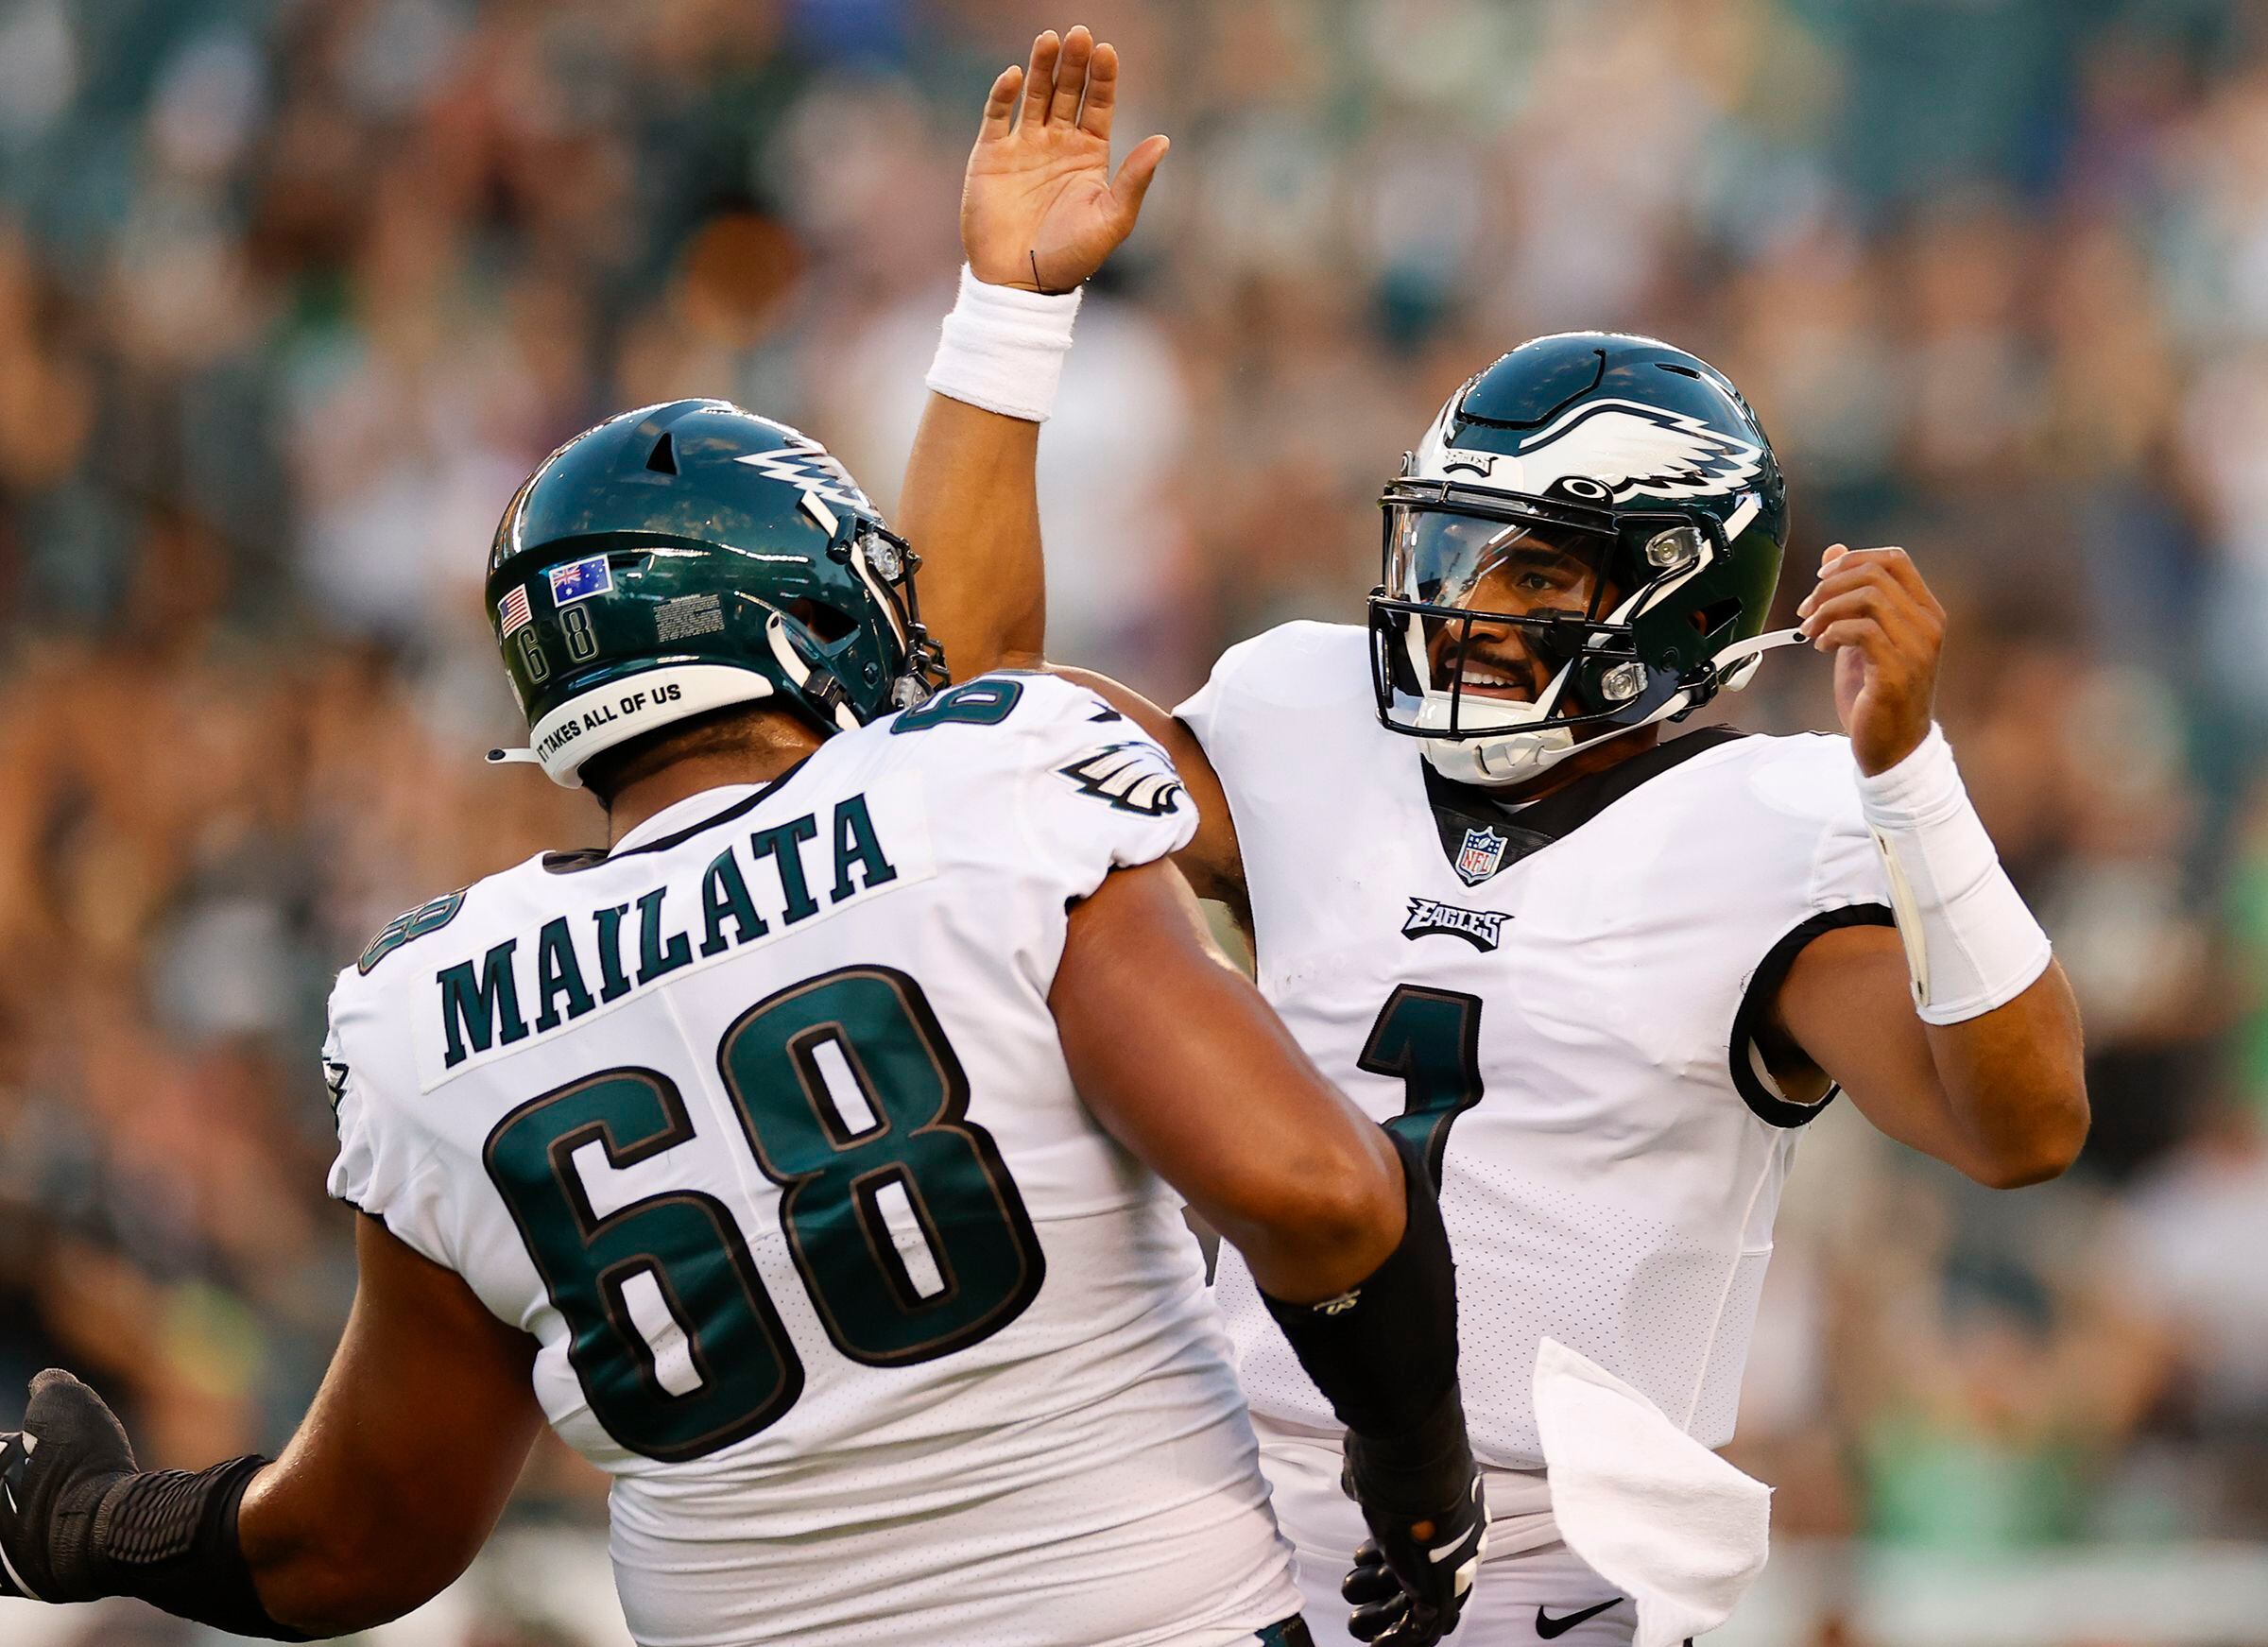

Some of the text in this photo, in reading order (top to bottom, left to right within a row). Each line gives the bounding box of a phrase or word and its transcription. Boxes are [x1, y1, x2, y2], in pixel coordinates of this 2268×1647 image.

[536, 684, 681, 763] IT TAKES ALL OF US
[436, 792, 898, 1070] MAILATA
[1461, 849, 1491, 873] NFL
[483, 964, 1047, 1463] 68
